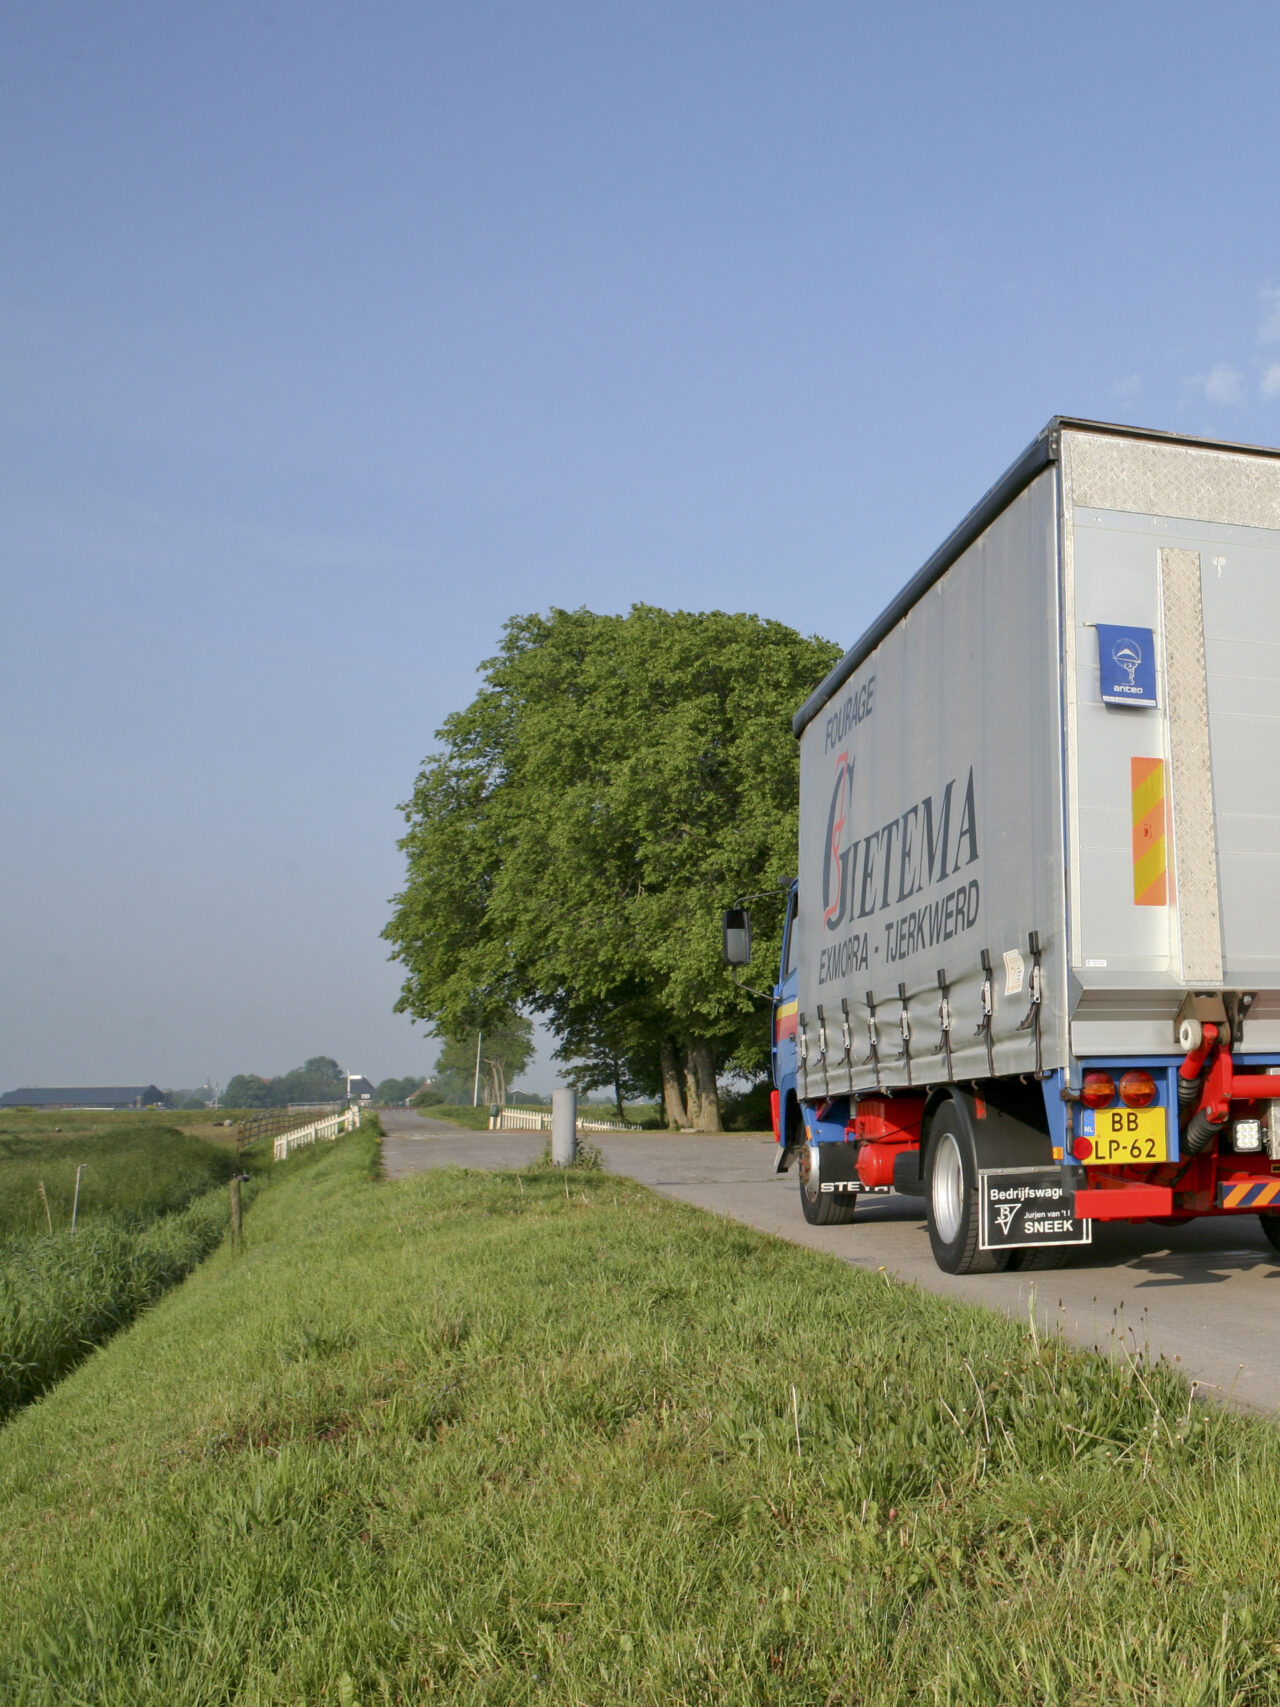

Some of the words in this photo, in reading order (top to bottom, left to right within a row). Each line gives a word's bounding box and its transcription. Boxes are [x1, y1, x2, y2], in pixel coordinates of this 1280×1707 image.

[1113, 685, 1144, 694] anteo
[824, 675, 876, 755] FOURAGE
[818, 932, 869, 985] EXMORRA
[884, 878, 980, 964] TJERKWERD
[1084, 1125, 1094, 1133] NL
[1094, 1138, 1156, 1160] LP-62
[1023, 1211, 1046, 1220] Jurjen
[1024, 1220, 1074, 1234] SNEEK
